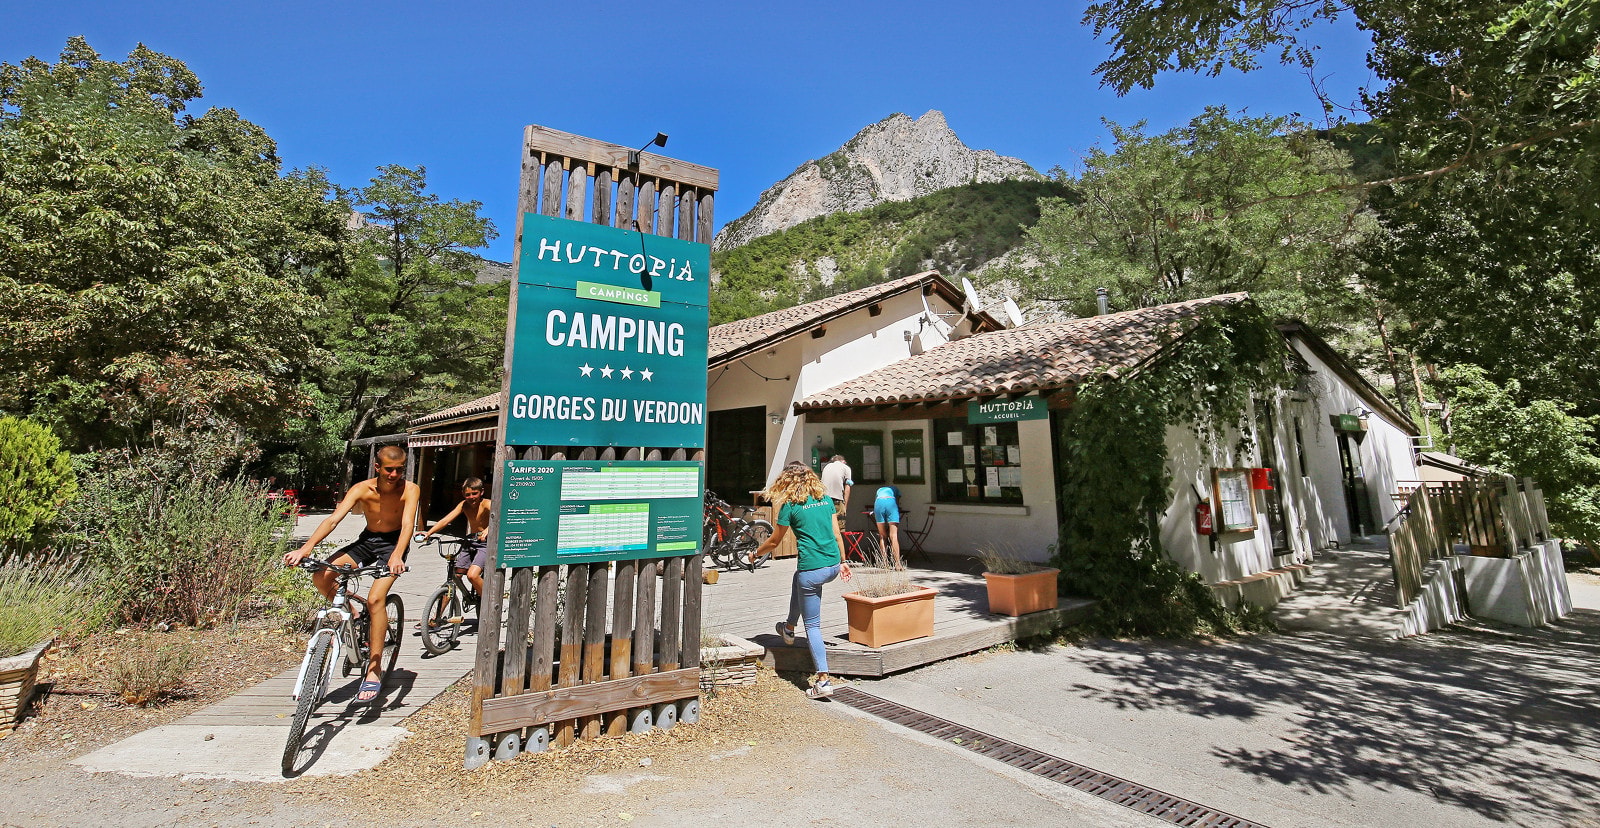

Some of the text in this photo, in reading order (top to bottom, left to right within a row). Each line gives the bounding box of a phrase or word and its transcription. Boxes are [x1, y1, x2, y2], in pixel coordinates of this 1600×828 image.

[589, 286, 649, 302] CAMPINGS
[545, 309, 685, 357] CAMPING
[512, 393, 703, 425] GORGES DU VERDON
